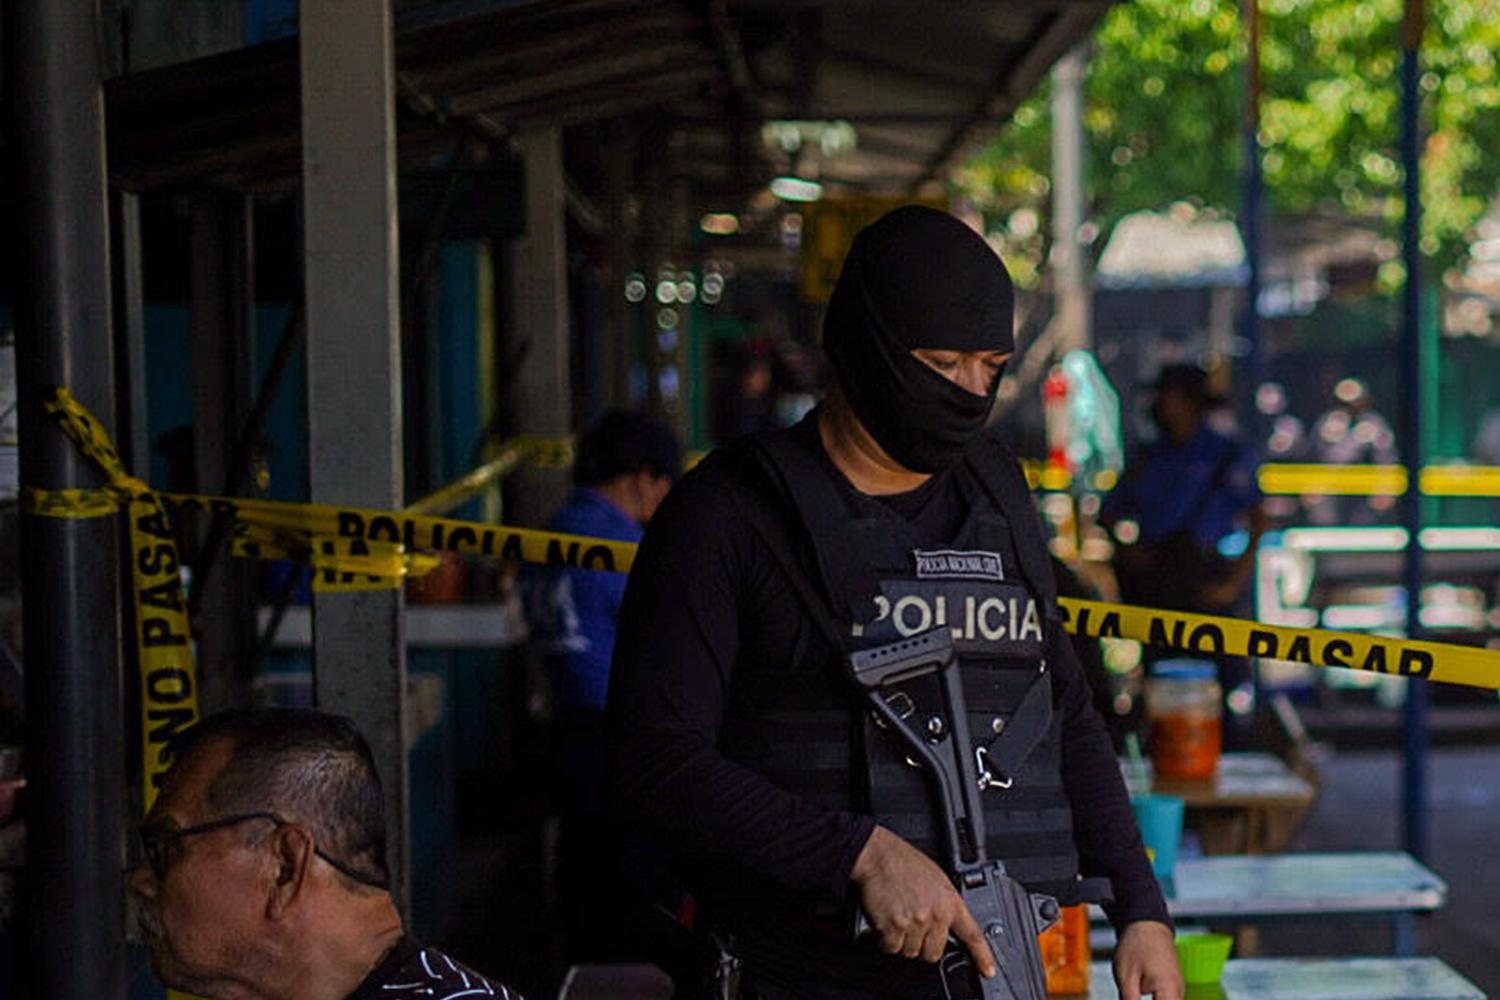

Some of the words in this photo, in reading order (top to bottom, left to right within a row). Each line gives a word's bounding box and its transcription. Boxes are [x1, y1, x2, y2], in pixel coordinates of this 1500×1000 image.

[138, 493, 187, 647] PASA
[545, 538, 616, 572] NO
[1149, 616, 1226, 652] NO
[1247, 629, 1435, 680] PASAR
